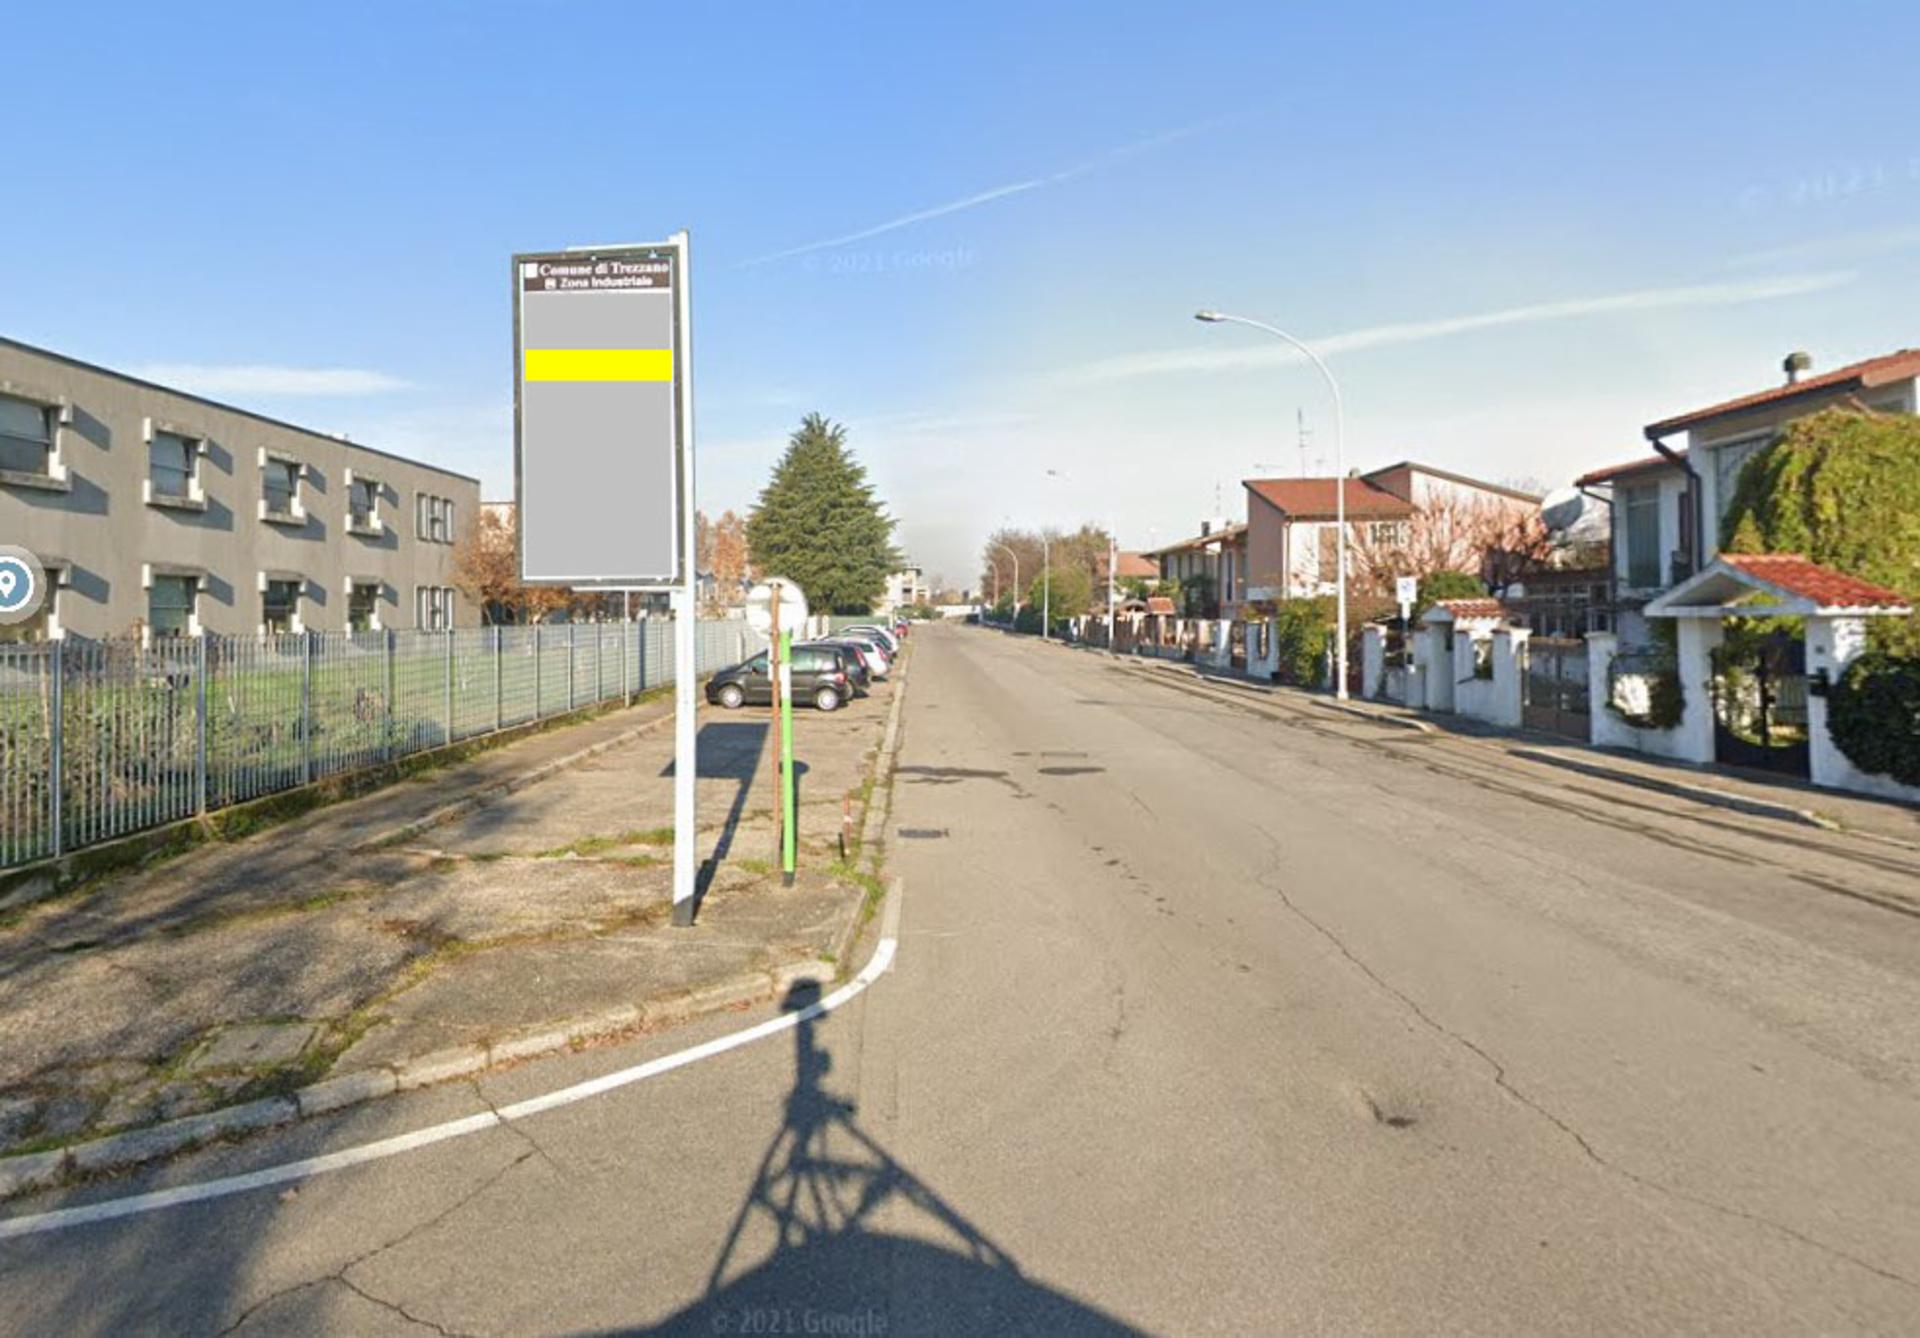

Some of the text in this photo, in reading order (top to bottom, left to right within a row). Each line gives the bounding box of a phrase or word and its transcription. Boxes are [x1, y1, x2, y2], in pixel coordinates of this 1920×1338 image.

[541, 260, 670, 276] Comune di Trezzano
[560, 275, 653, 289] Zona Industriale
